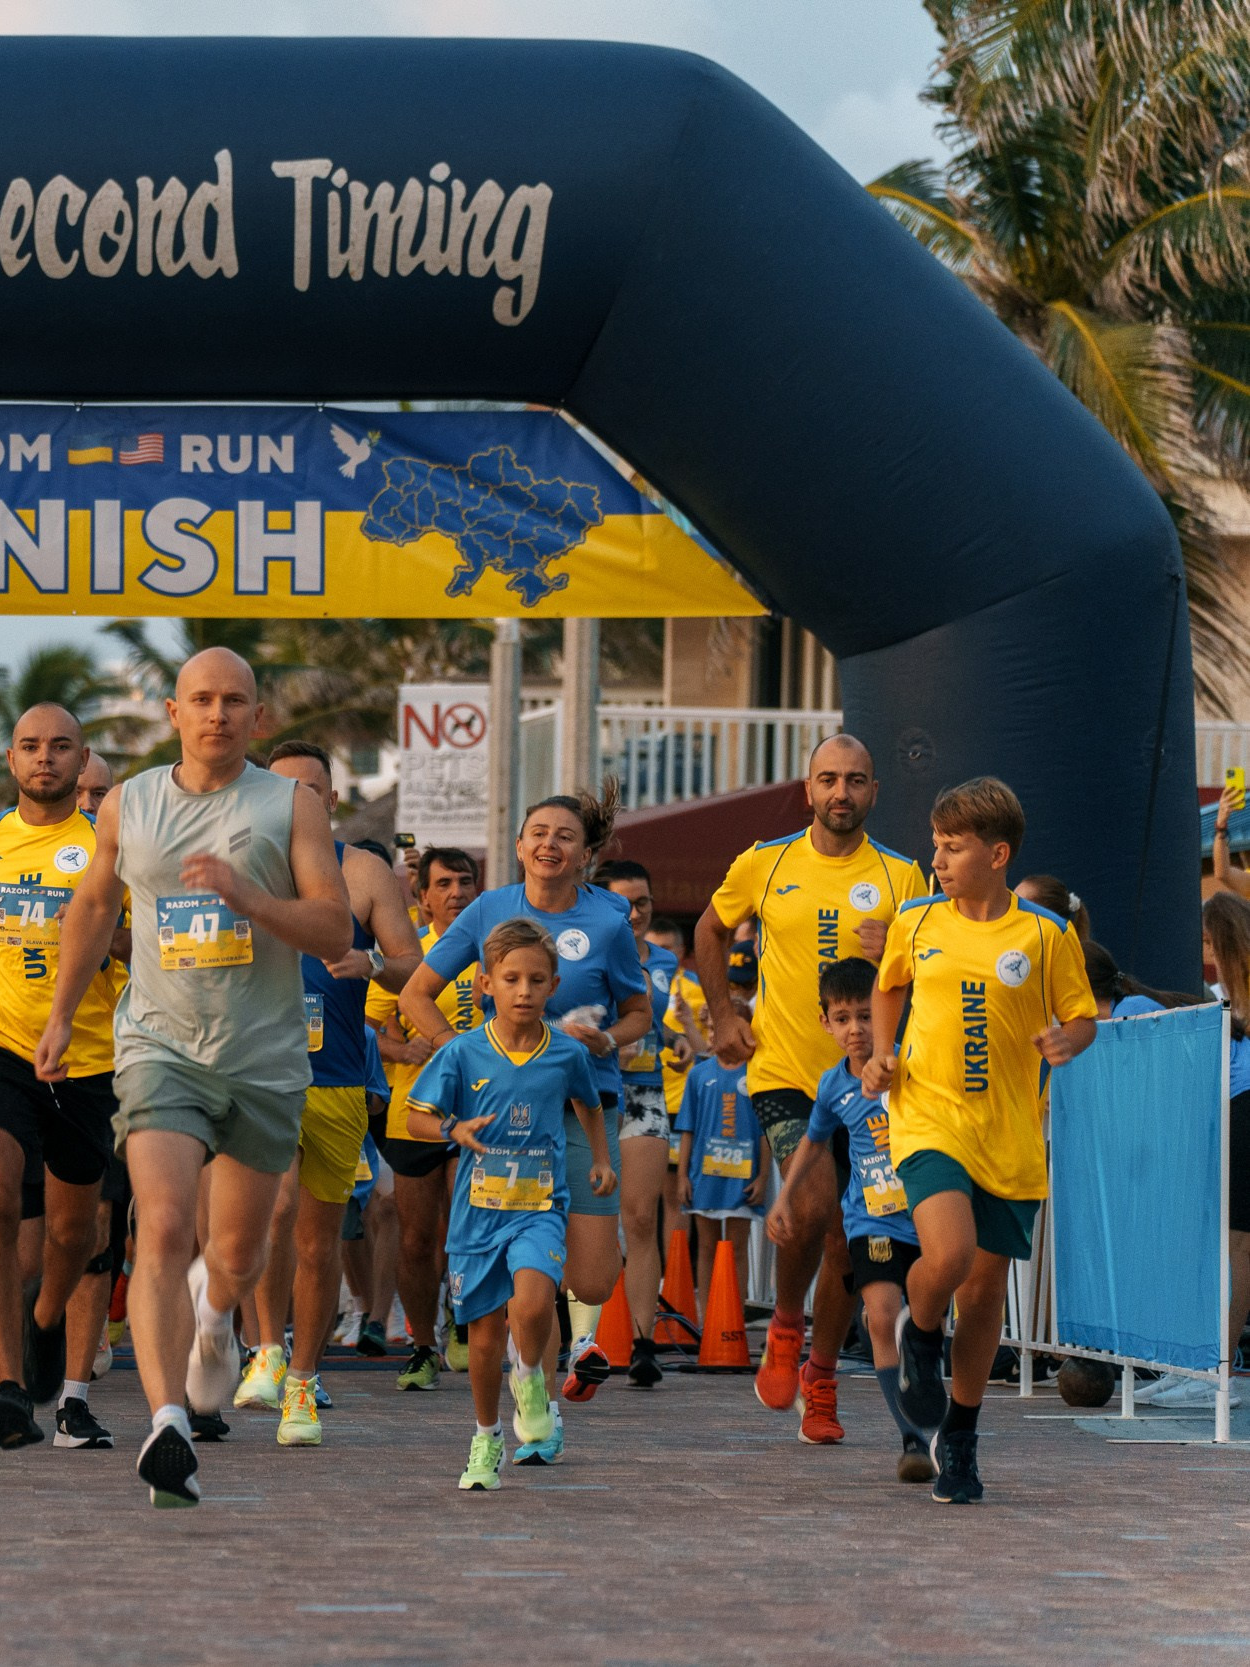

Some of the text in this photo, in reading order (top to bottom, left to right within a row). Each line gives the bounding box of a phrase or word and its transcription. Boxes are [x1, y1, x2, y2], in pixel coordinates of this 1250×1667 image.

[270, 158, 553, 327] Timing
[180, 434, 295, 475] RUN
[1, 886, 65, 897] RAZOM RUN
[165, 900, 199, 910] RAZOM
[17, 900, 46, 928] 74
[188, 912, 220, 944] 47
[455, 979, 473, 1031] RAINE
[961, 980, 989, 1093] UKRAINE
[721, 1092, 737, 1137] RAINE
[486, 1147, 547, 1157] AZOM RUN
[712, 1146, 743, 1166] 328
[862, 1154, 888, 1166] RAZOM
[505, 1161, 520, 1189] 7
